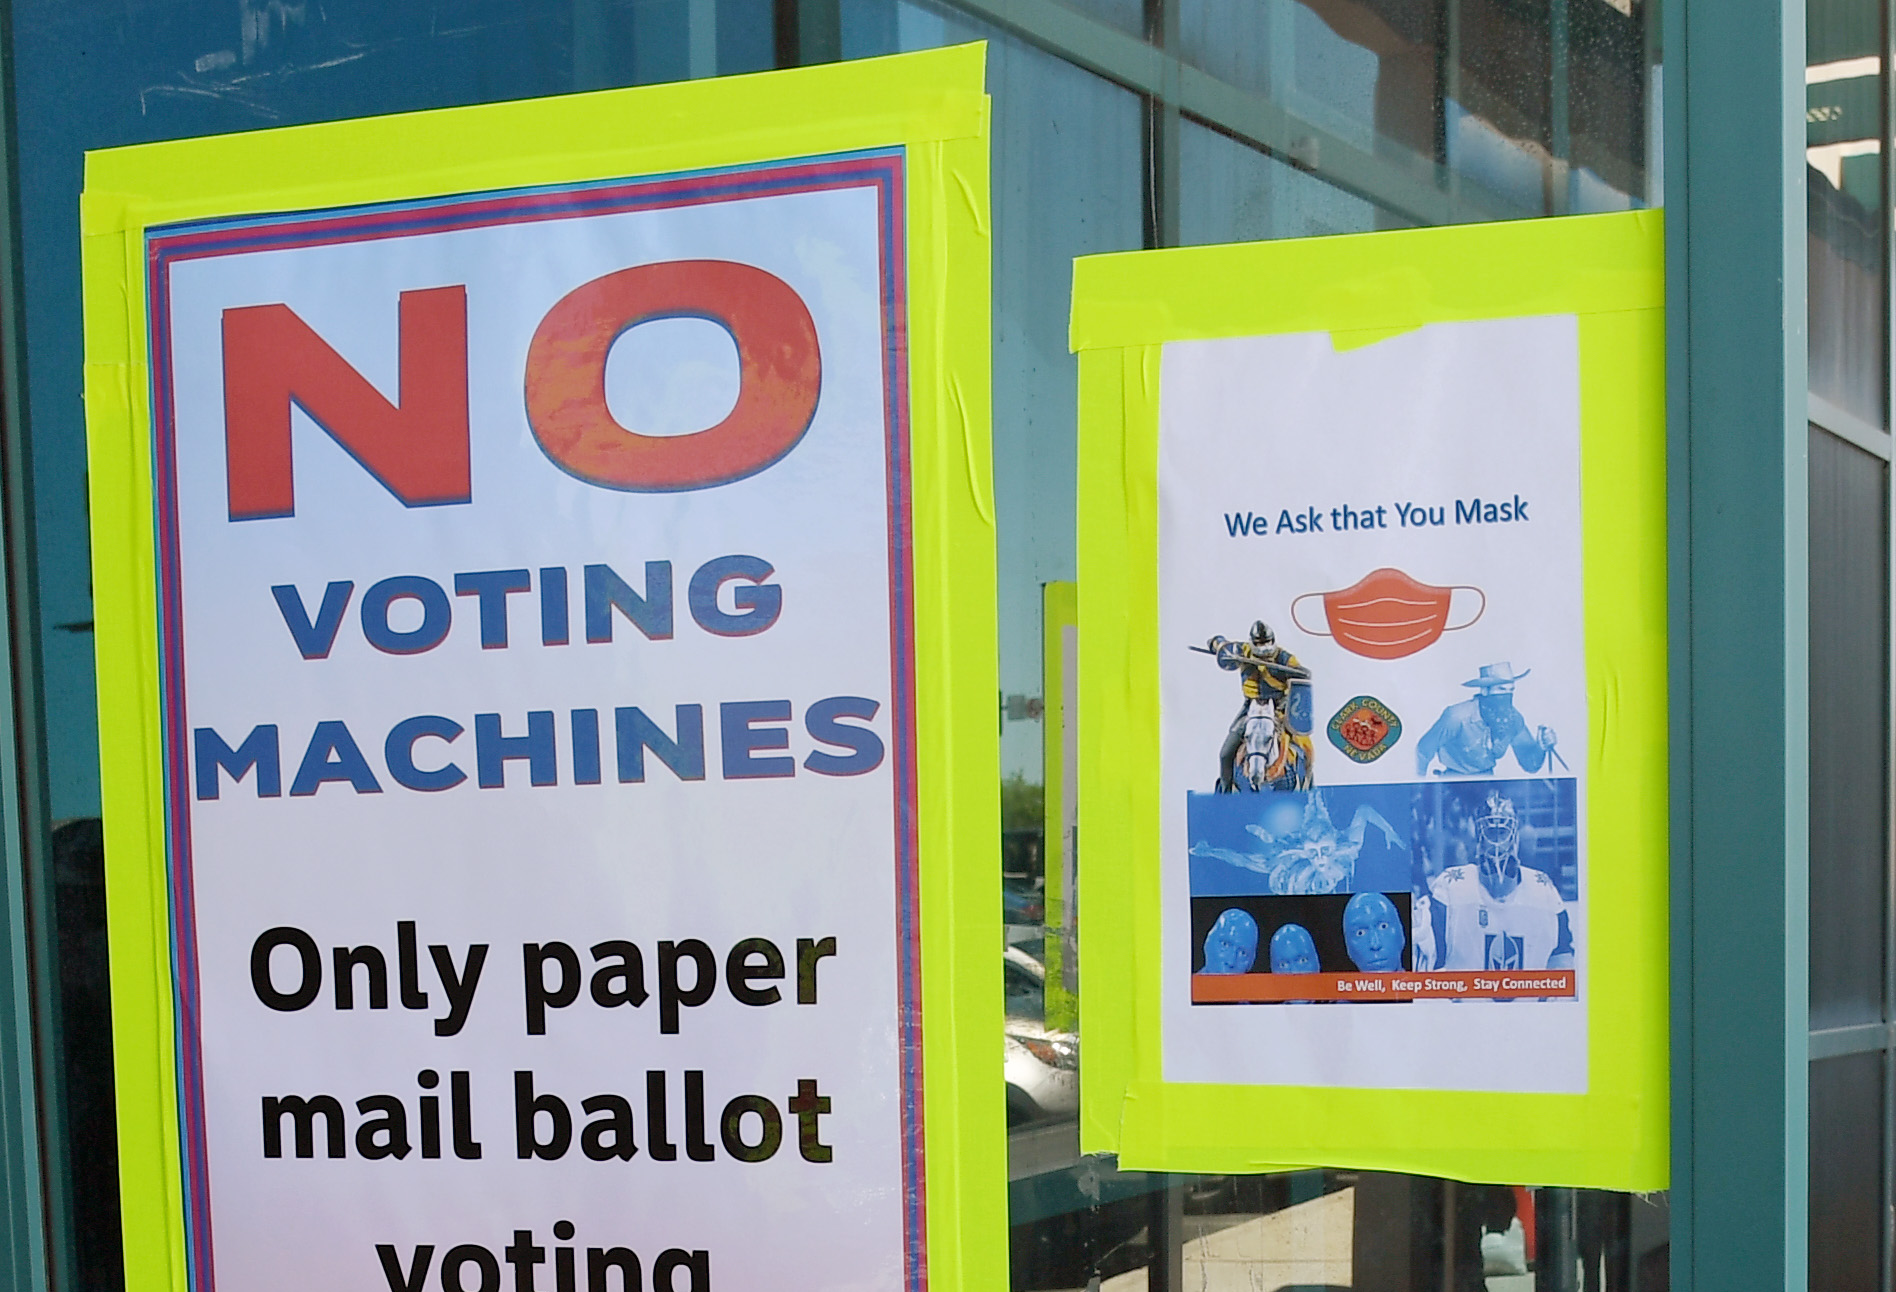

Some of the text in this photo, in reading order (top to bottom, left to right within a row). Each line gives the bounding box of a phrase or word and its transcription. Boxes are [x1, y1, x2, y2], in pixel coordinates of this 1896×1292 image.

[220, 258, 823, 523] NO
[1223, 494, 1529, 538] We Ask that You Mask
[270, 554, 784, 661] VOTING
[193, 696, 886, 801] MACHINES
[1331, 698, 1398, 731] CLARK COUNTY
[1344, 743, 1387, 761] NEVADA
[249, 920, 838, 1038] Only paper
[1337, 976, 1568, 993] Be Well, Keep Strong, Stay Connected
[260, 1068, 834, 1164] mail ballot
